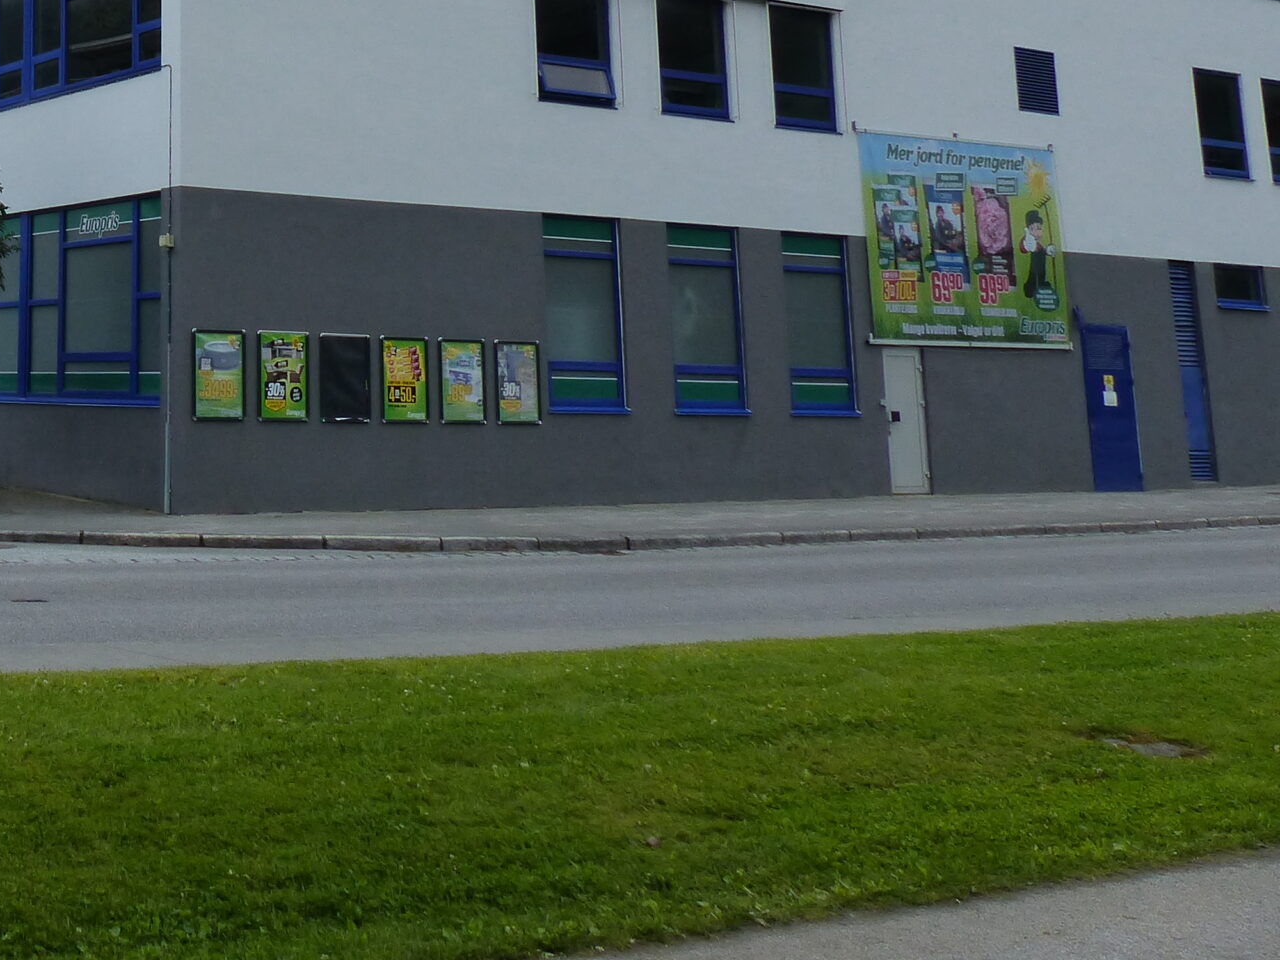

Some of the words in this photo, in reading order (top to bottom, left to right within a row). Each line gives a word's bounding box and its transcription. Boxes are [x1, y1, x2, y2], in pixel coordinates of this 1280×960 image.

[886, 143, 913, 161] Mer
[913, 146, 944, 167] jord
[946, 150, 966, 166] for
[968, 155, 1025, 173] pengene!
[79, 211, 120, 238] Europris
[1021, 317, 1065, 335] Europris
[389, 386, 395, 402] 4
